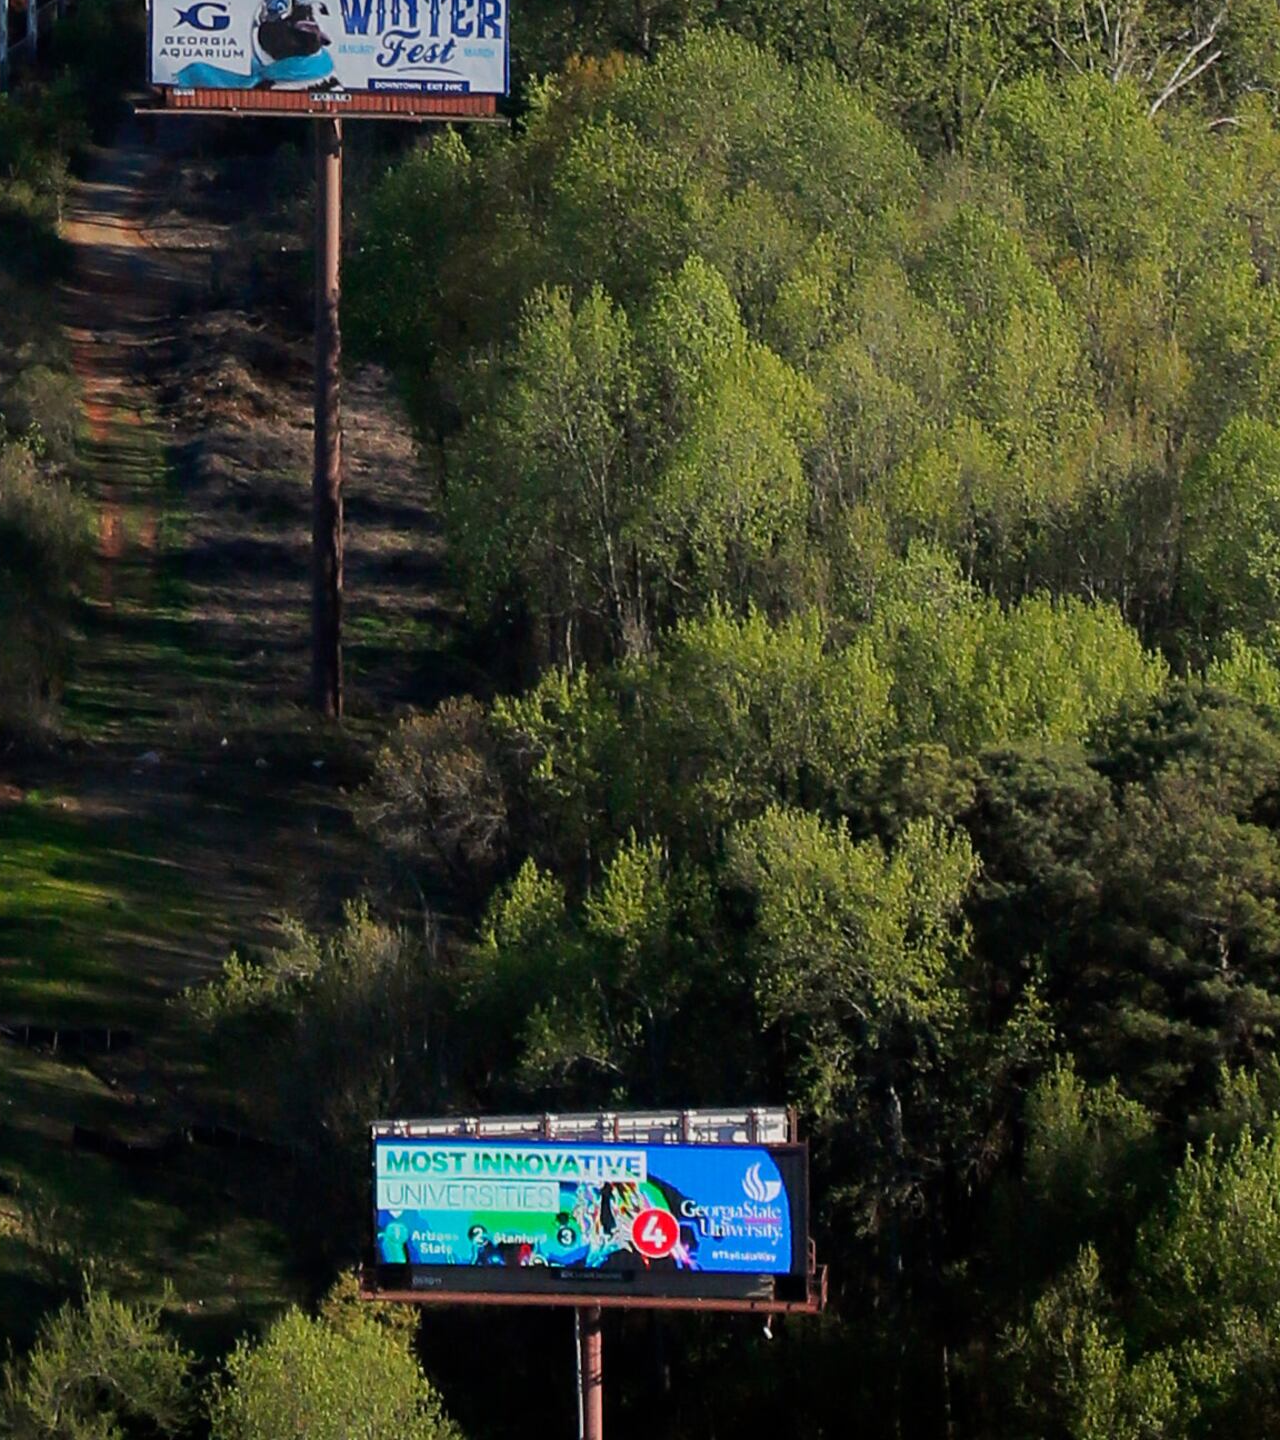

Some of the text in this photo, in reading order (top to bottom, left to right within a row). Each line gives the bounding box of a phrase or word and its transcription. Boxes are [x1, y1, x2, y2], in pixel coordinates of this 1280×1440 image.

[164, 35, 238, 46] GEORGIA
[376, 30, 457, 68] Fest
[159, 48, 244, 58] AQUARIUM
[374, 81, 422, 90] DOWNTOWN
[385, 1151, 641, 1177] MOST INNOVATIVE
[386, 1182, 555, 1208] UNIVERSITIES
[473, 1227, 484, 1243] 2
[561, 1230, 572, 1244] 3
[642, 1215, 668, 1249] 4
[420, 1242, 453, 1255] State
